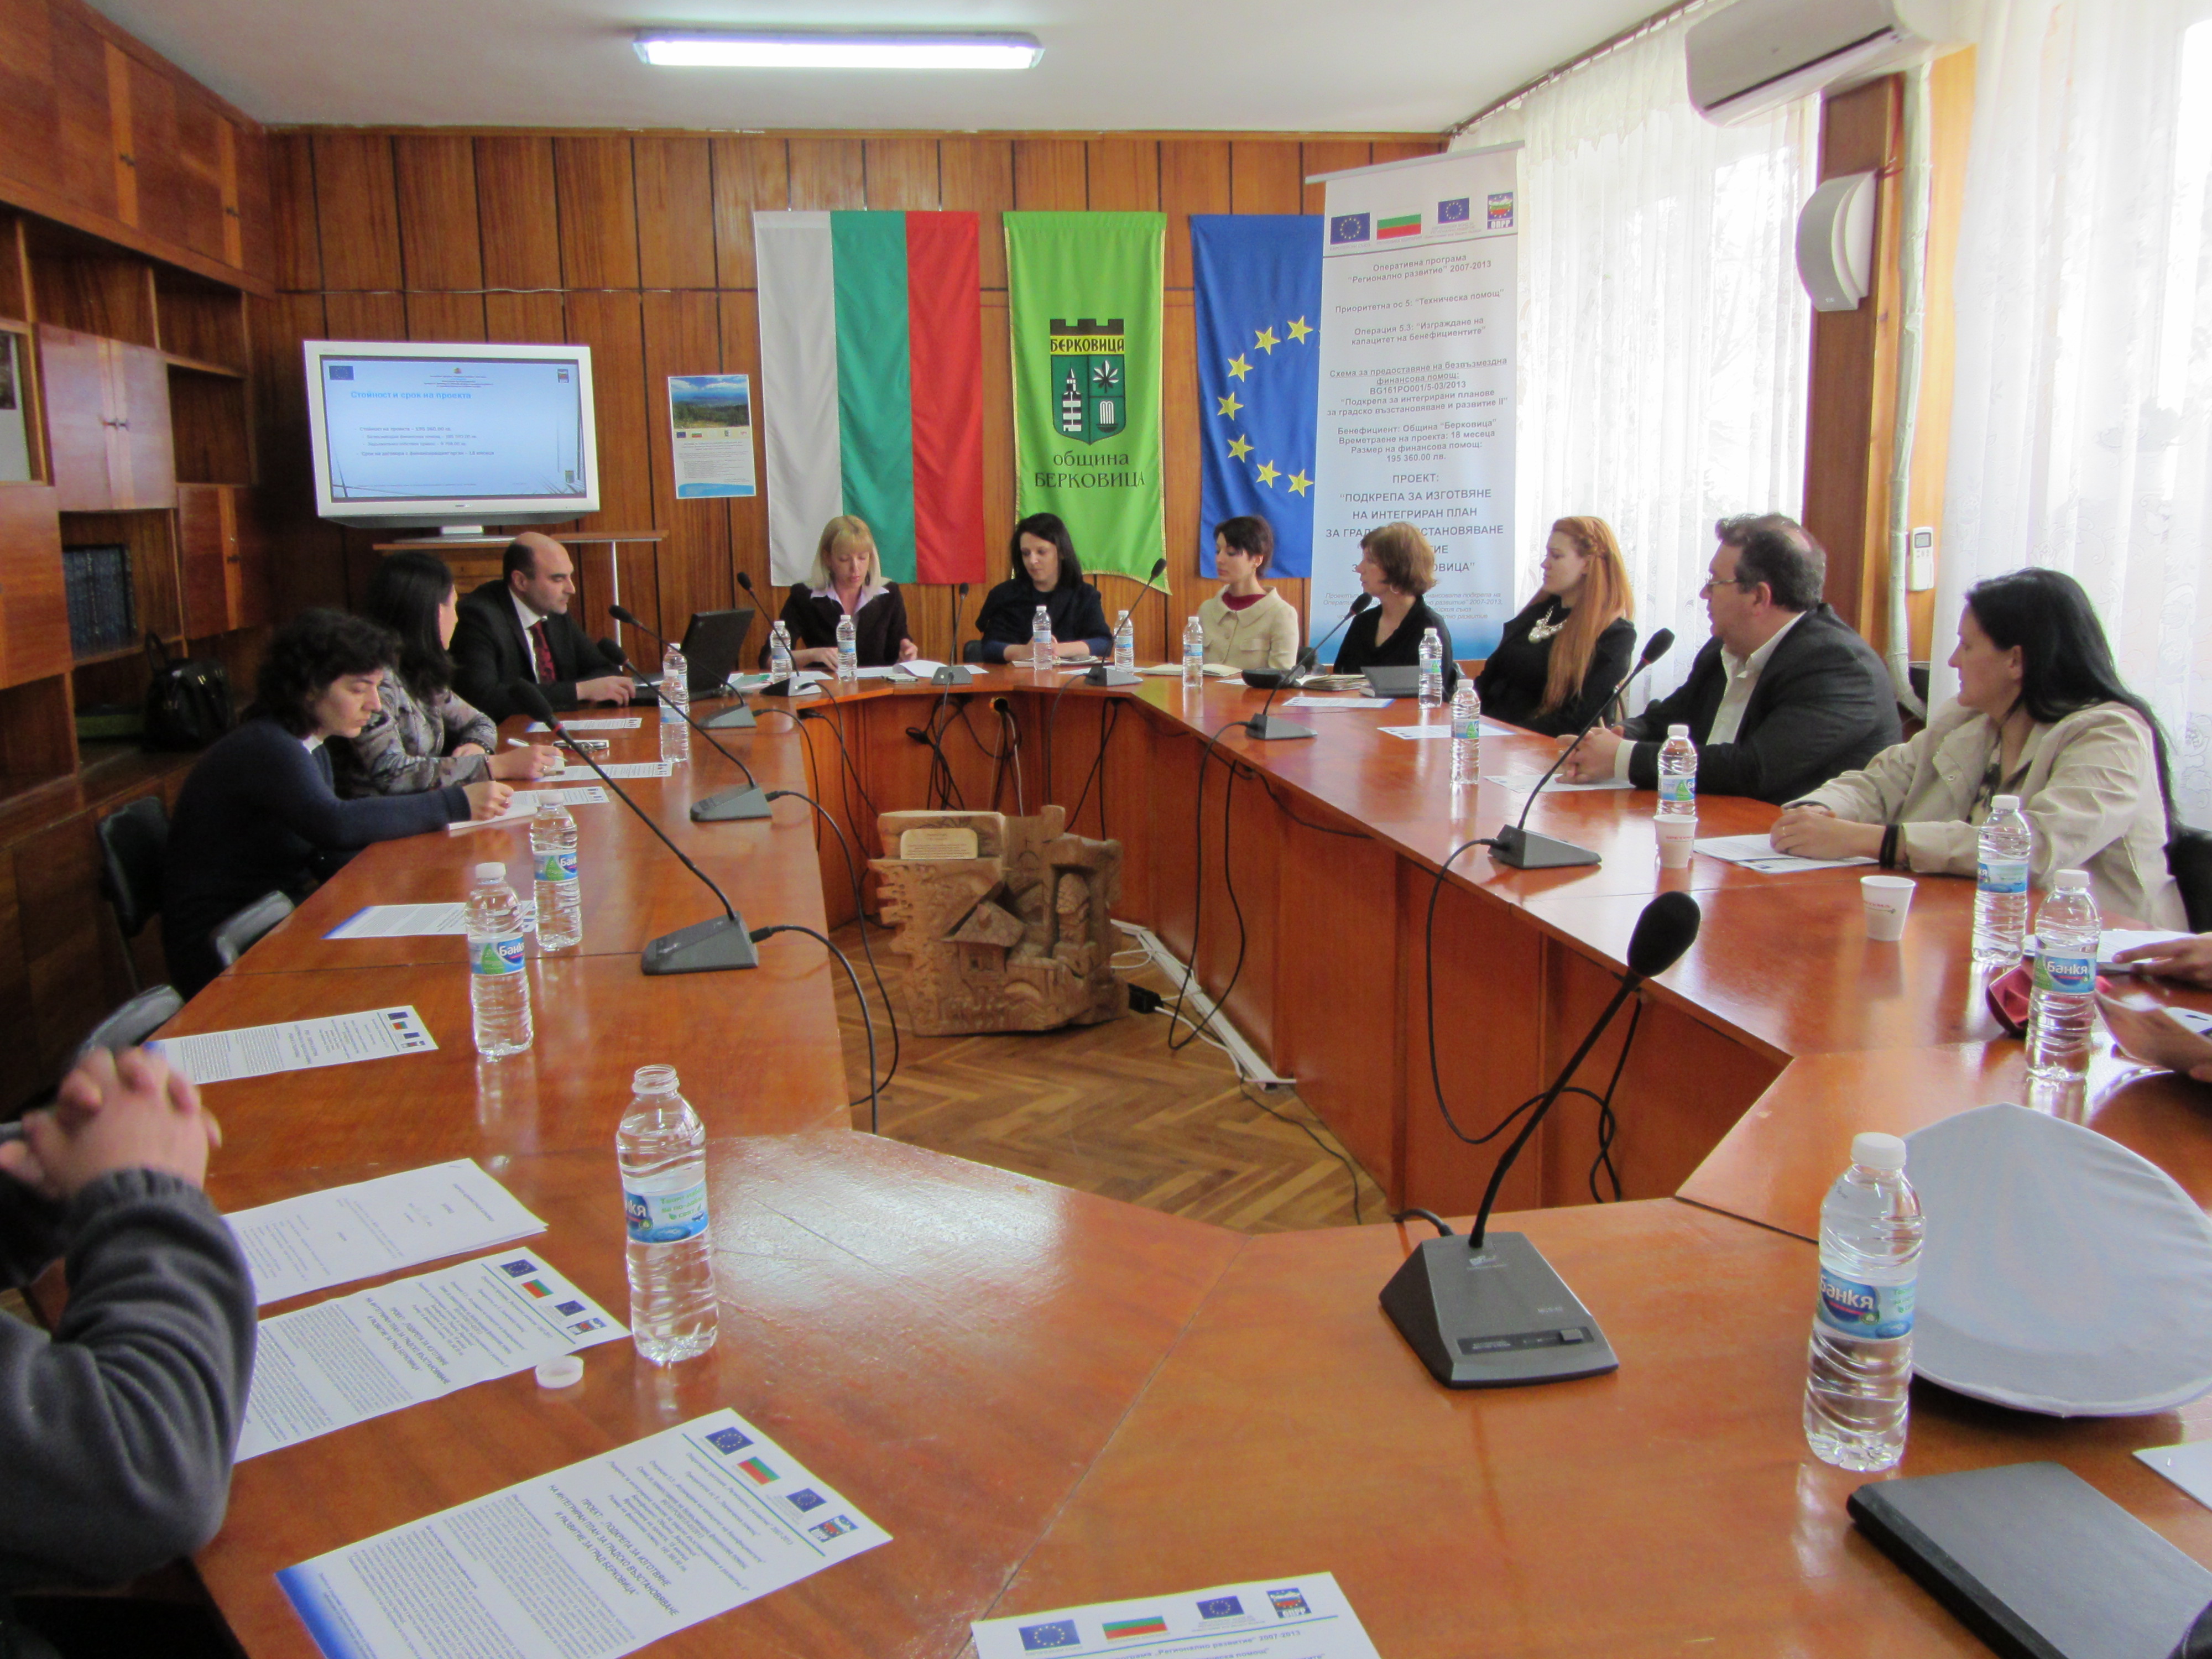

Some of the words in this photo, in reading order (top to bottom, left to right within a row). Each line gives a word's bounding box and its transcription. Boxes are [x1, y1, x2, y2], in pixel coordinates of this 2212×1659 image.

[1490, 220, 1510, 229] ОПРР
[1373, 260, 1423, 272] Оперативна
[1426, 255, 1467, 265] програма
[1450, 260, 1491, 272] 2007-2013
[1335, 303, 1390, 314] Приоритетна
[1354, 326, 1397, 336] Операция
[1051, 338, 1124, 352] БЕРКОВИЦА
[1352, 336, 1394, 346] капацитет
[1329, 369, 1357, 378] Схема
[1370, 365, 1431, 377] предоставяне
[1444, 358, 1507, 369] безвъзмездна
[1376, 375, 1425, 386] финансова
[1427, 372, 1459, 382] помощ:
[436, 392, 471, 400] проекта
[1401, 392, 1455, 403] интегрирани
[1458, 390, 1495, 398] планове
[1339, 408, 1373, 417] градско
[1375, 403, 1445, 414] възстановяване
[1455, 399, 1496, 410] развитие
[1338, 425, 1400, 435] Бенефициент:
[1402, 424, 1438, 434] Община
[1339, 435, 1396, 445] Времетраене
[1411, 433, 1448, 444] проекта:
[1463, 430, 1495, 439] месеца
[1351, 446, 1383, 455] Размер
[1398, 442, 1447, 453] финансова
[1449, 441, 1483, 450] помощ:
[1053, 451, 1129, 466] община
[1404, 453, 1431, 462] 360.00
[1035, 472, 1145, 488] БЕРКОВИЦА
[1392, 473, 1439, 483] ПРОЕКТ:
[1408, 492, 1422, 500] ЗА
[1426, 489, 1491, 500] ИЗГОТВЯНЕ
[1353, 510, 1368, 519] НА
[1371, 509, 1443, 519] ИНТЕГРИРАН
[1447, 508, 1477, 517] ПЛАН
[1326, 529, 1340, 538] ЗА
[1343, 528, 1370, 538] ГРАД
[1421, 525, 1504, 536] СТАНОВЯВАНЕ
[2047, 961, 2089, 975] Банкя
[1820, 1274, 1875, 1310] Банкя
